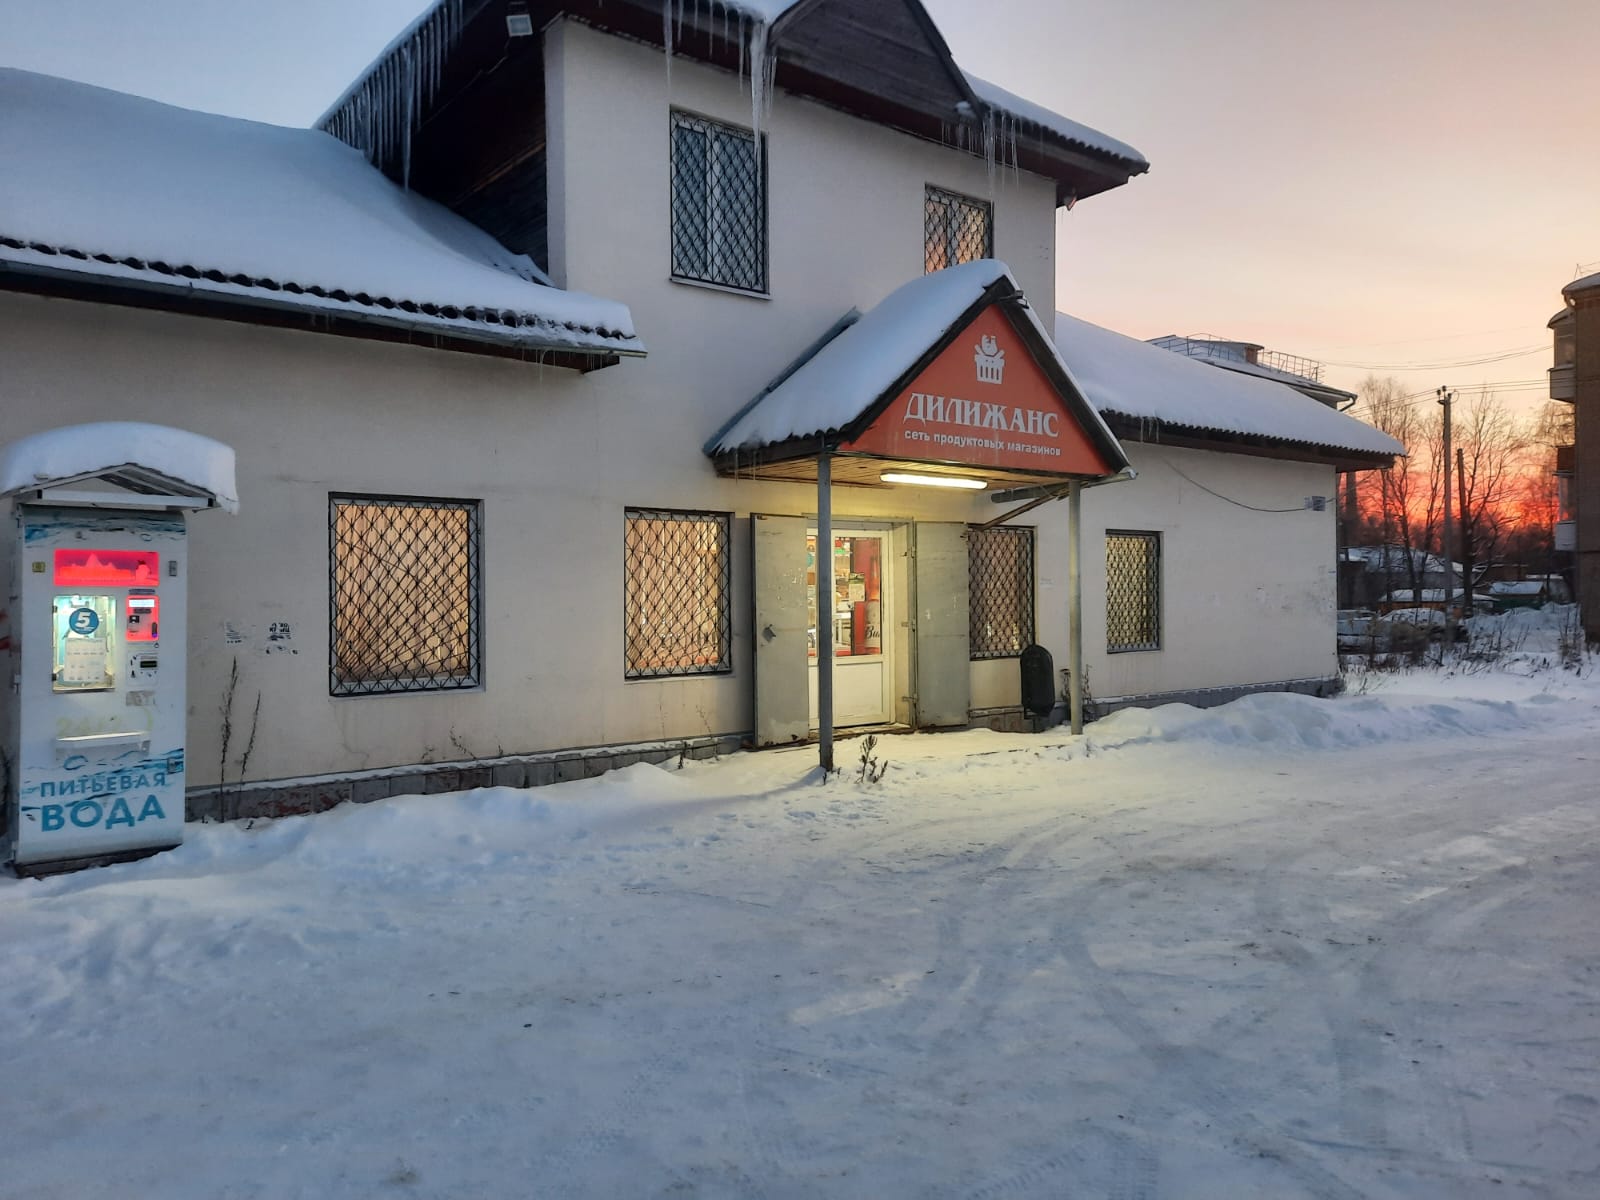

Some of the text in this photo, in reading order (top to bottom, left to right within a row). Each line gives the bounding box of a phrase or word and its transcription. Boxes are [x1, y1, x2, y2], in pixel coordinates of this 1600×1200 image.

[903, 392, 1059, 438] ДИЛИЖАНС
[904, 430, 1061, 456] сеть продуктовых магазинов
[75, 611, 91, 628] 5
[40, 772, 166, 797] ПИТЬЕВАЯ
[41, 794, 166, 832] ВОДА
